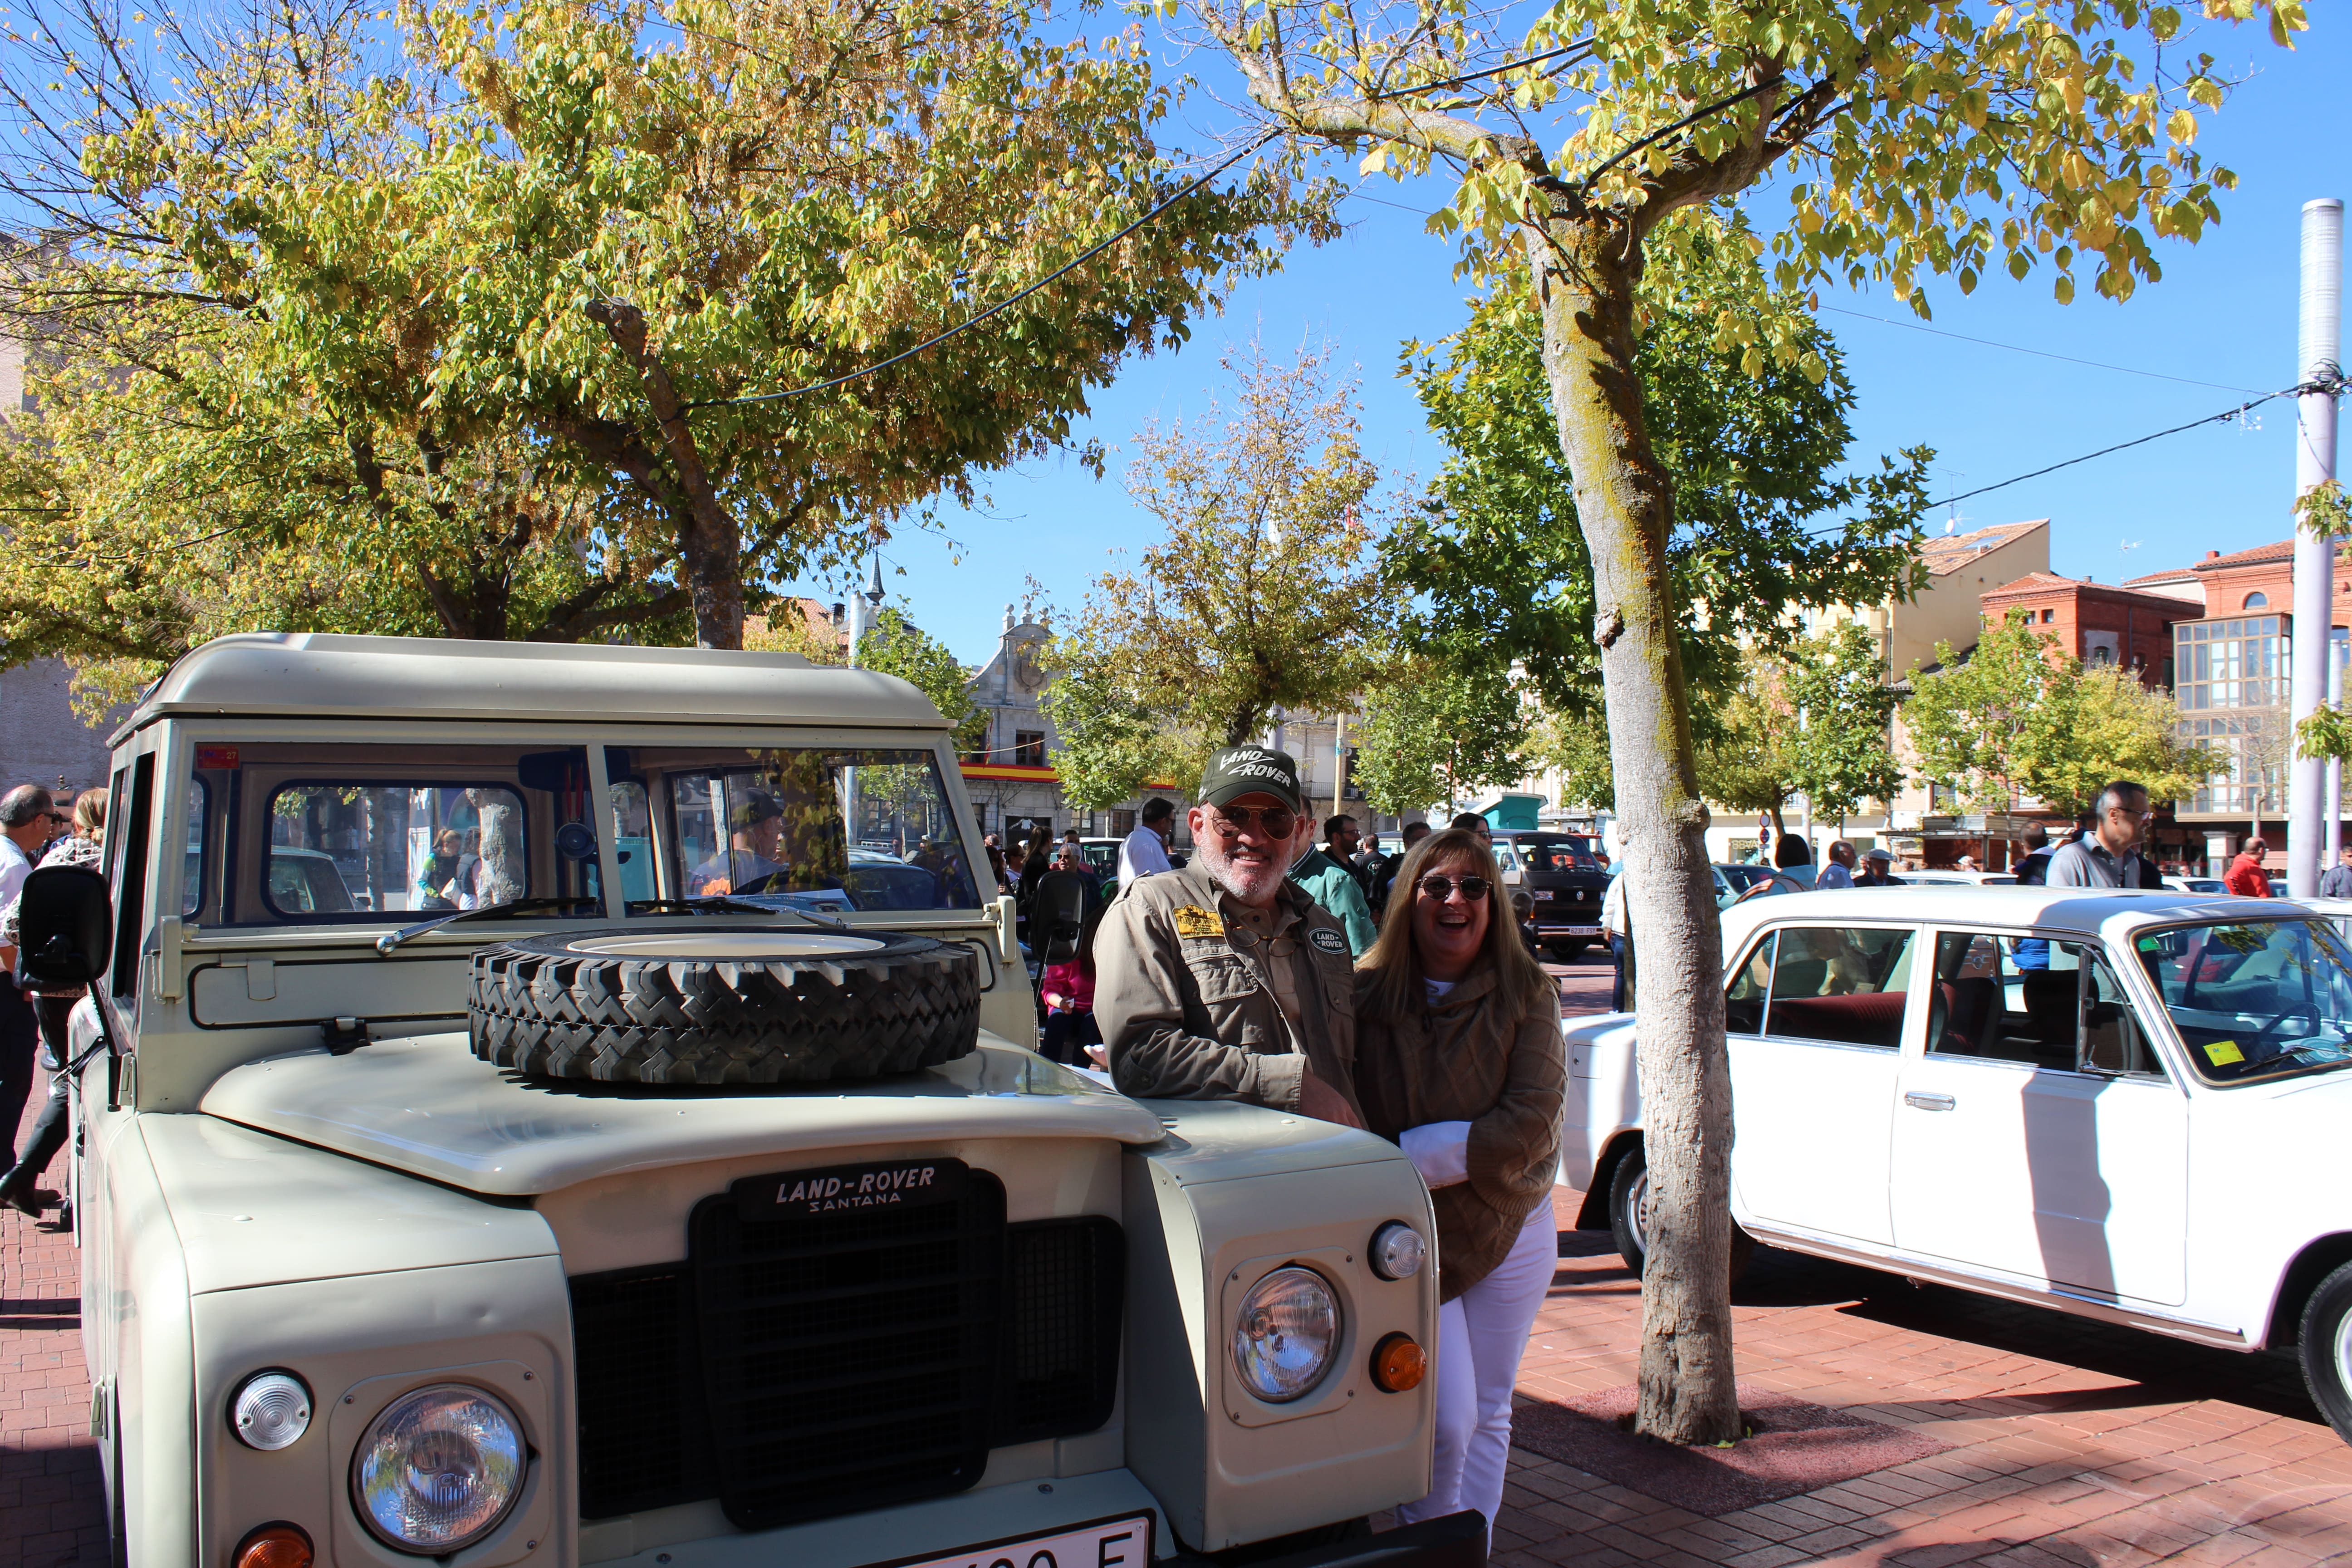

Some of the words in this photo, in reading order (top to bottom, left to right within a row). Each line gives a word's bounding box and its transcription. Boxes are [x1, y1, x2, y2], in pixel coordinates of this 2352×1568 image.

[1219, 750, 1263, 771] LAND
[1240, 764, 1290, 787] ROVER
[1732, 840, 1758, 849] BBVA
[776, 1167, 935, 1203] LAND-ROVER
[809, 1192, 901, 1212] SANTANA
